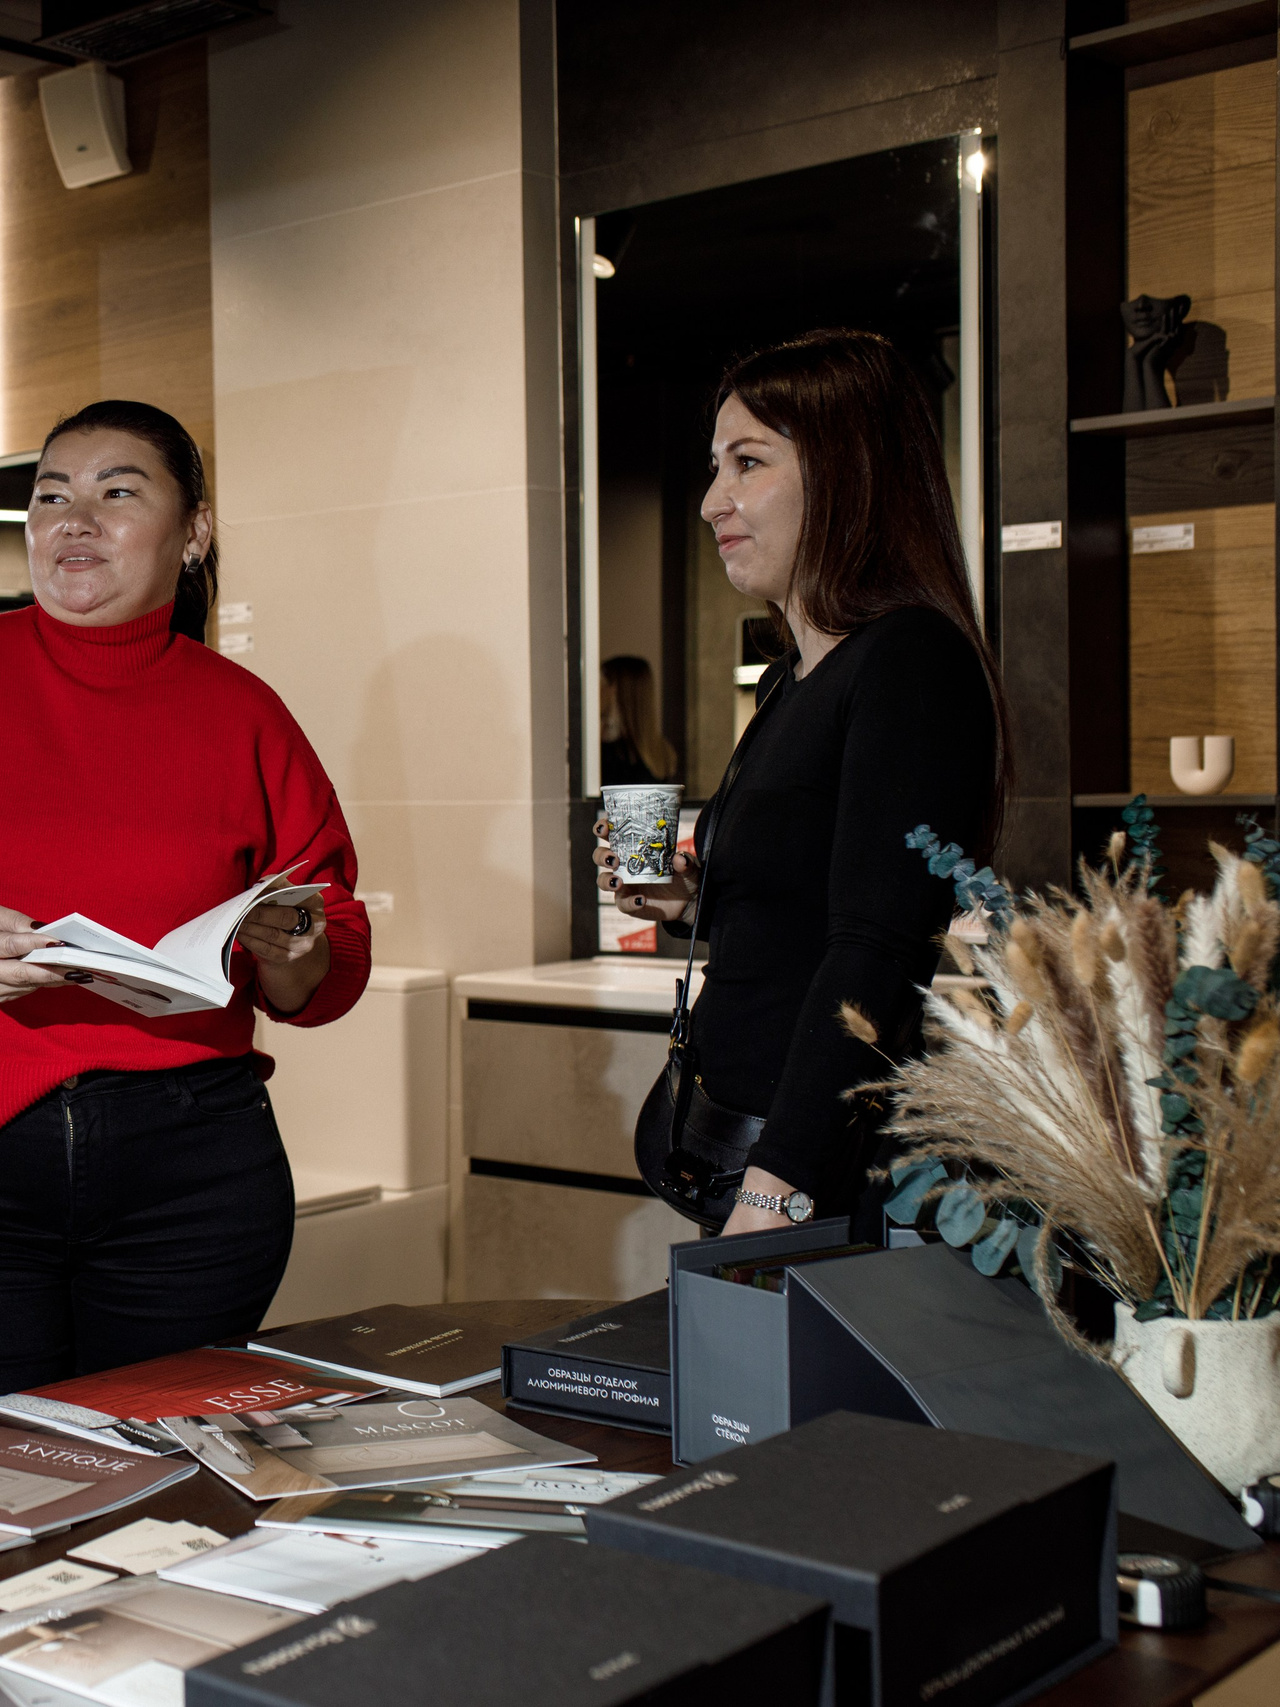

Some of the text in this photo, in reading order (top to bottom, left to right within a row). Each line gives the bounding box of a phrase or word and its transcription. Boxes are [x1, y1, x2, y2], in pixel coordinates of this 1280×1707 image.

[547, 1367, 638, 1391] ОБРАЗЦЫ ОТДЕЛОК
[202, 1379, 305, 1410] ESSE
[527, 1378, 660, 1407] АЛЮМИНИЕВОГО ПРОФИЛЯ
[353, 1418, 465, 1435] MASCOT
[711, 1413, 750, 1433] ОБРАЗЦЫ
[7, 1443, 135, 1472] ANTIQUE
